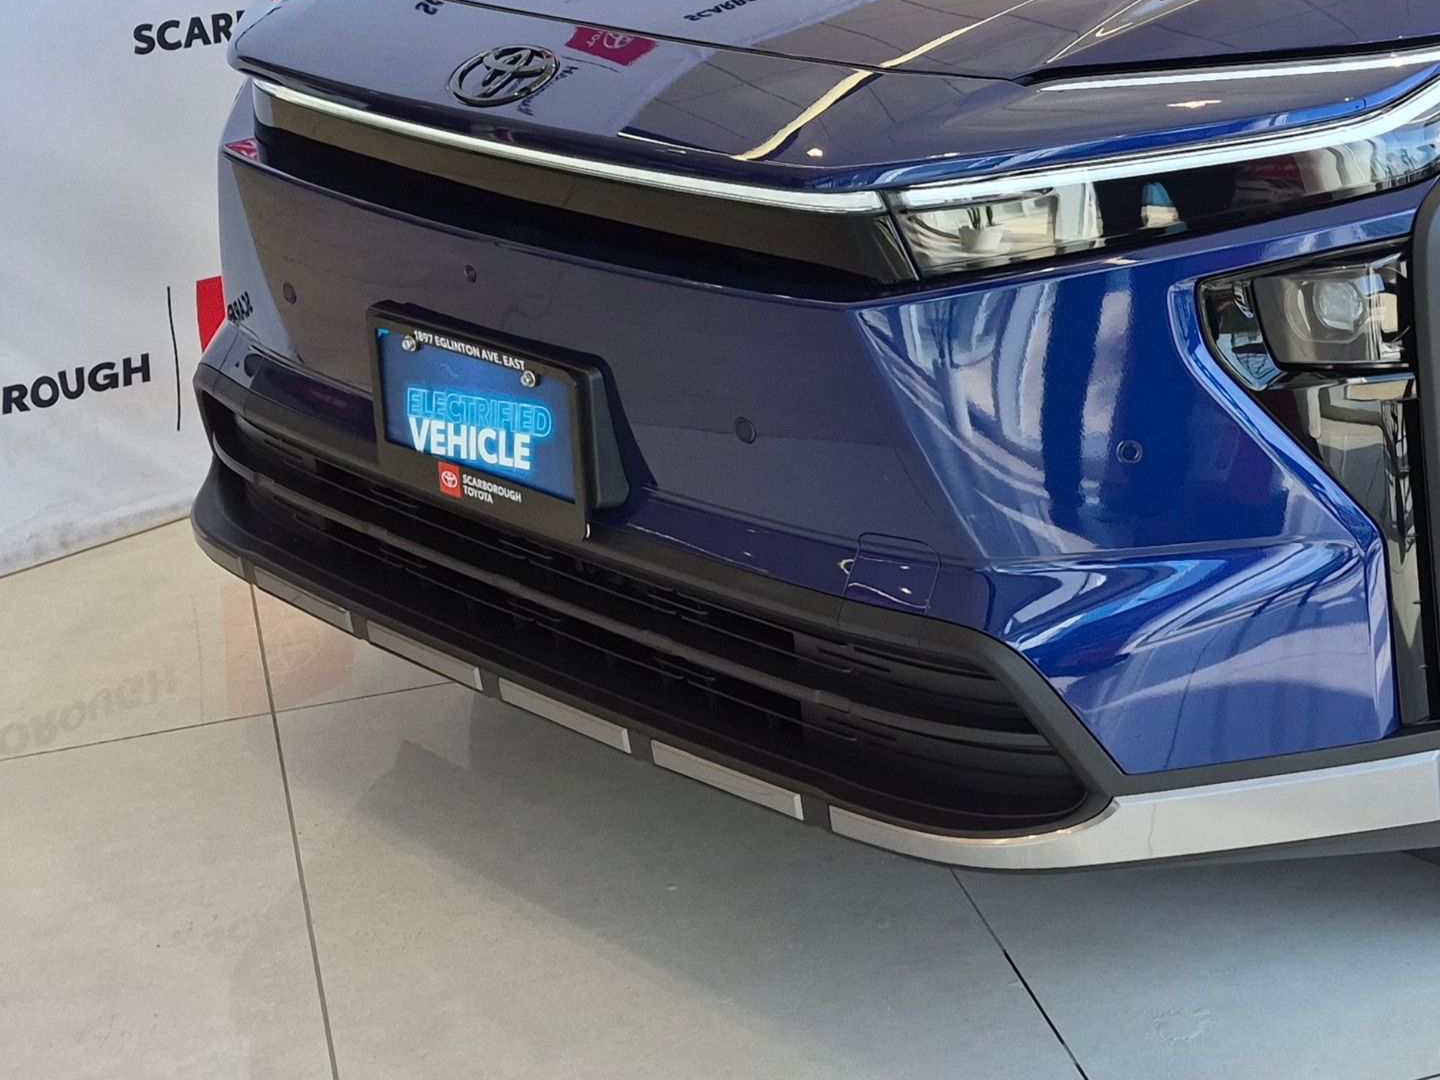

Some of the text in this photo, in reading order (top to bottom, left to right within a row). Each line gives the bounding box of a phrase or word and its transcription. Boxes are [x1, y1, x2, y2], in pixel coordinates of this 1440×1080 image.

[133, 9, 246, 56] SCAR
[413, 330, 525, 371] 1897 EGLINTON AVE. EAST
[2, 352, 152, 416] ROUGH
[406, 386, 553, 438] ELECTRIFIED
[407, 416, 532, 471] VEHICLE
[462, 473, 523, 503] SCARBOROUGH
[462, 484, 494, 505] TOYOTA
